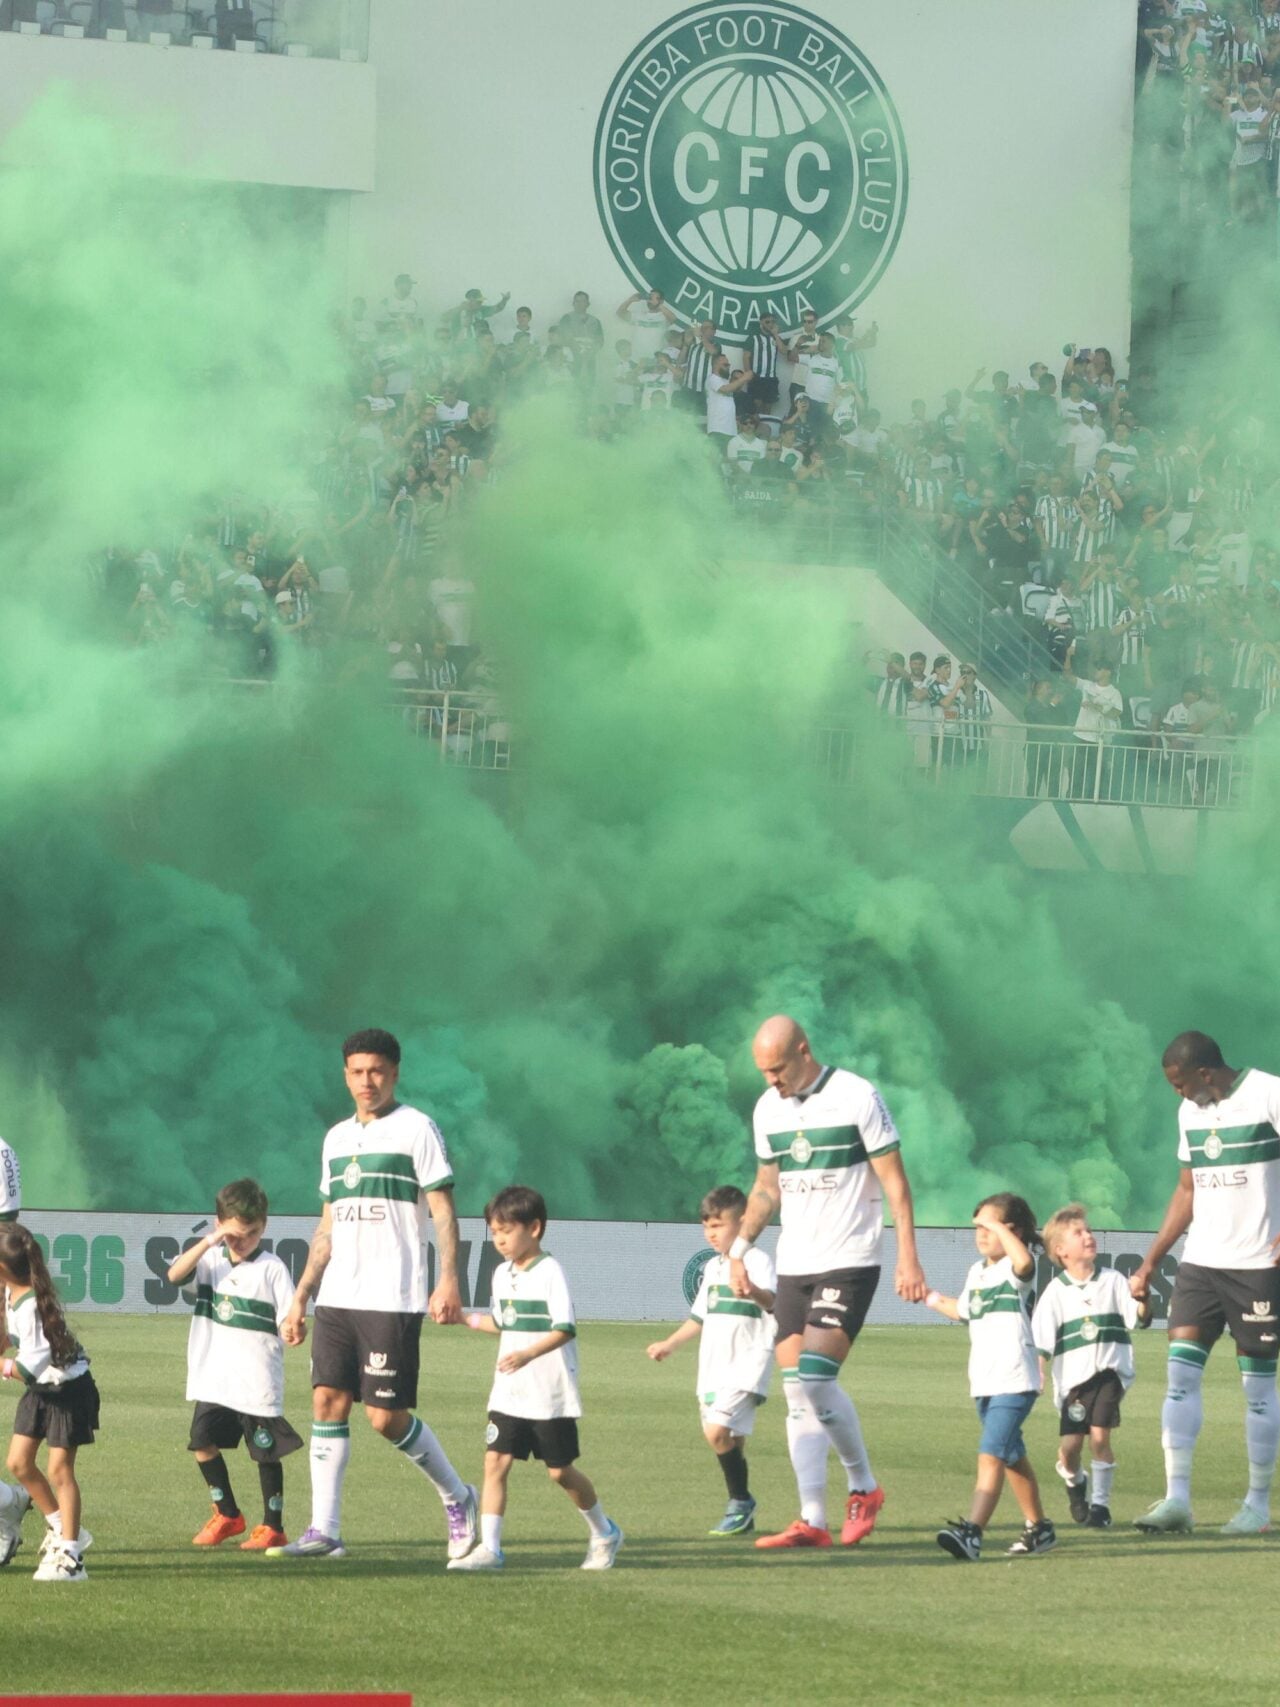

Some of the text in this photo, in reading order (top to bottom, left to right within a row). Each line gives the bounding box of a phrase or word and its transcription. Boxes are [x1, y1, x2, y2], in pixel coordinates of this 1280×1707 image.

[610, 15, 892, 233] CORITIBA FOOT BALL CLUB
[673, 131, 831, 214] CFC
[675, 276, 818, 330] PARANÁ
[33, 1233, 126, 1304] 36
